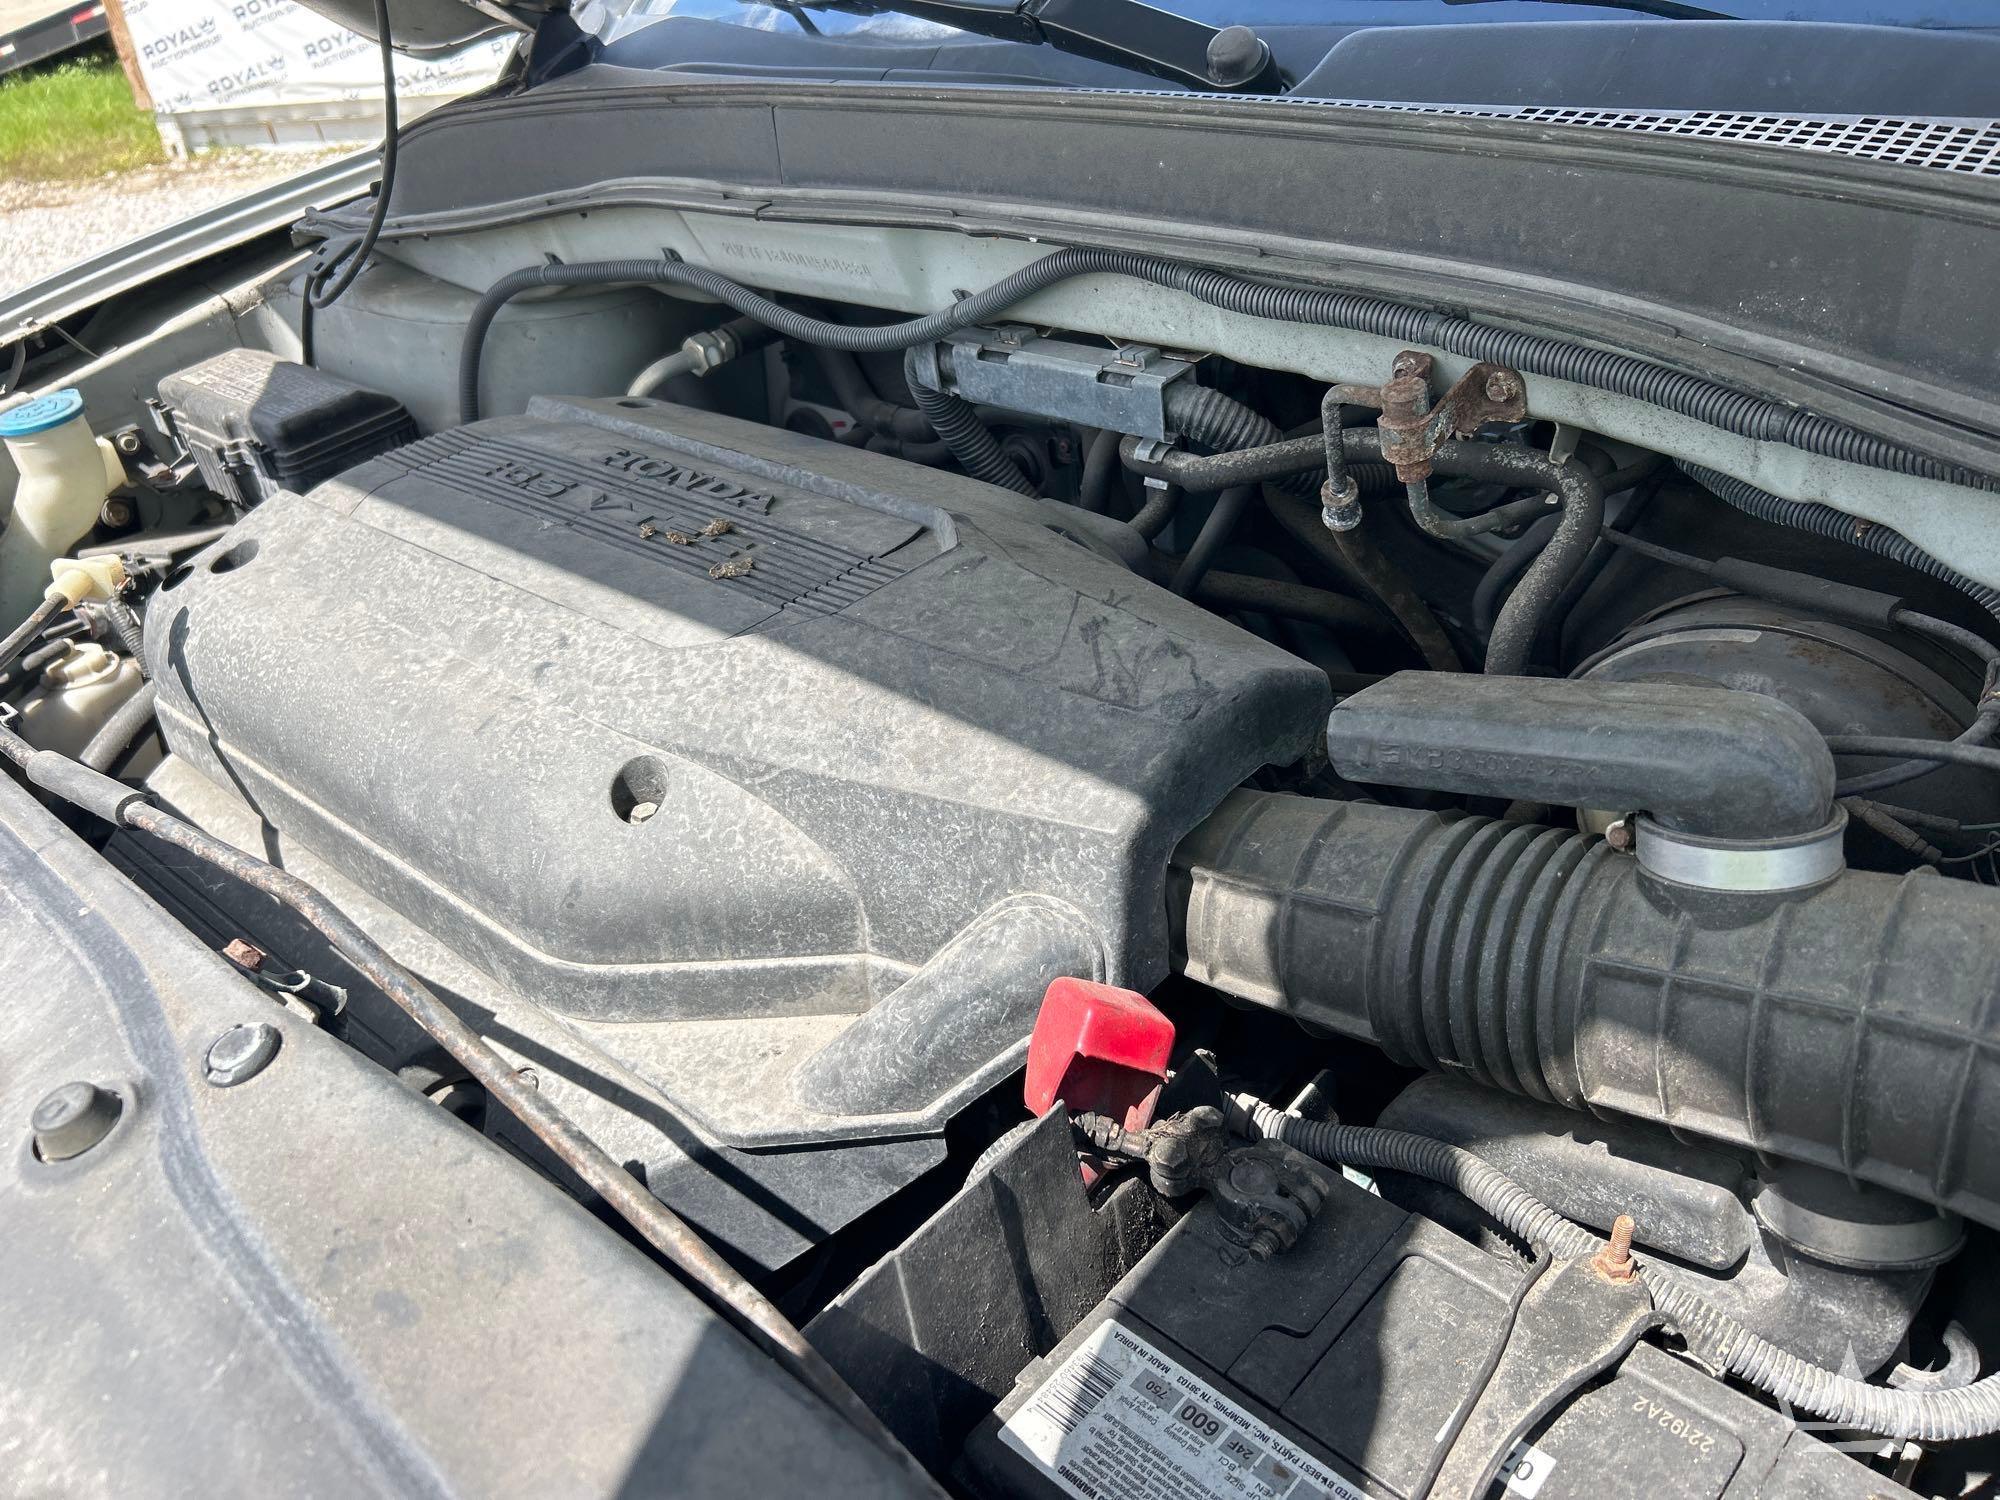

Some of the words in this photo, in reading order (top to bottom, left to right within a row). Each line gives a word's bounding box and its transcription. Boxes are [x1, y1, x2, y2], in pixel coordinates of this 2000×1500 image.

[142, 23, 202, 60] ROYAL
[302, 24, 358, 60] ROYA
[206, 59, 268, 98] ROYAL
[395, 61, 447, 89] OYAL
[604, 447, 776, 515] HONDA
[1113, 1330, 1139, 1351] KOREA
[1138, 1347, 1148, 1358] IN
[1145, 1353, 1171, 1374] MADE
[1144, 1379, 1168, 1400] 750
[1176, 1374, 1201, 1394] 38103
[1117, 1393, 1135, 1409] Amps
[1199, 1390, 1212, 1402] TN
[1132, 1405, 1158, 1426] Cranking
[1178, 1402, 1221, 1438] 600
[1210, 1397, 1251, 1430] MEMPHIS,
[1632, 1395, 1716, 1453] 22192A2
[1093, 1430, 1119, 1452] California
[1162, 1425, 1188, 1447] Cranking
[1181, 1428, 1189, 1437] at
[1187, 1433, 1206, 1448] Amps
[1249, 1425, 1270, 1443] INC.,
[1121, 1451, 1139, 1467] State
[1185, 1443, 1201, 1457] Cold
[1226, 1437, 1254, 1460] 24F
[1268, 1439, 1300, 1464] PARTS,
[1171, 1462, 1182, 1473] go
[1217, 1455, 1237, 1471] BCI
[1299, 1460, 1322, 1480] BEST
[1058, 1465, 1097, 1497] WARNING
[1119, 1473, 1146, 1495] California
[1121, 1463, 1147, 1485] Batteries
[1165, 1472, 1184, 1488] Wash
[1178, 1469, 1211, 1495] information
[1223, 1472, 1246, 1491] SIZE
